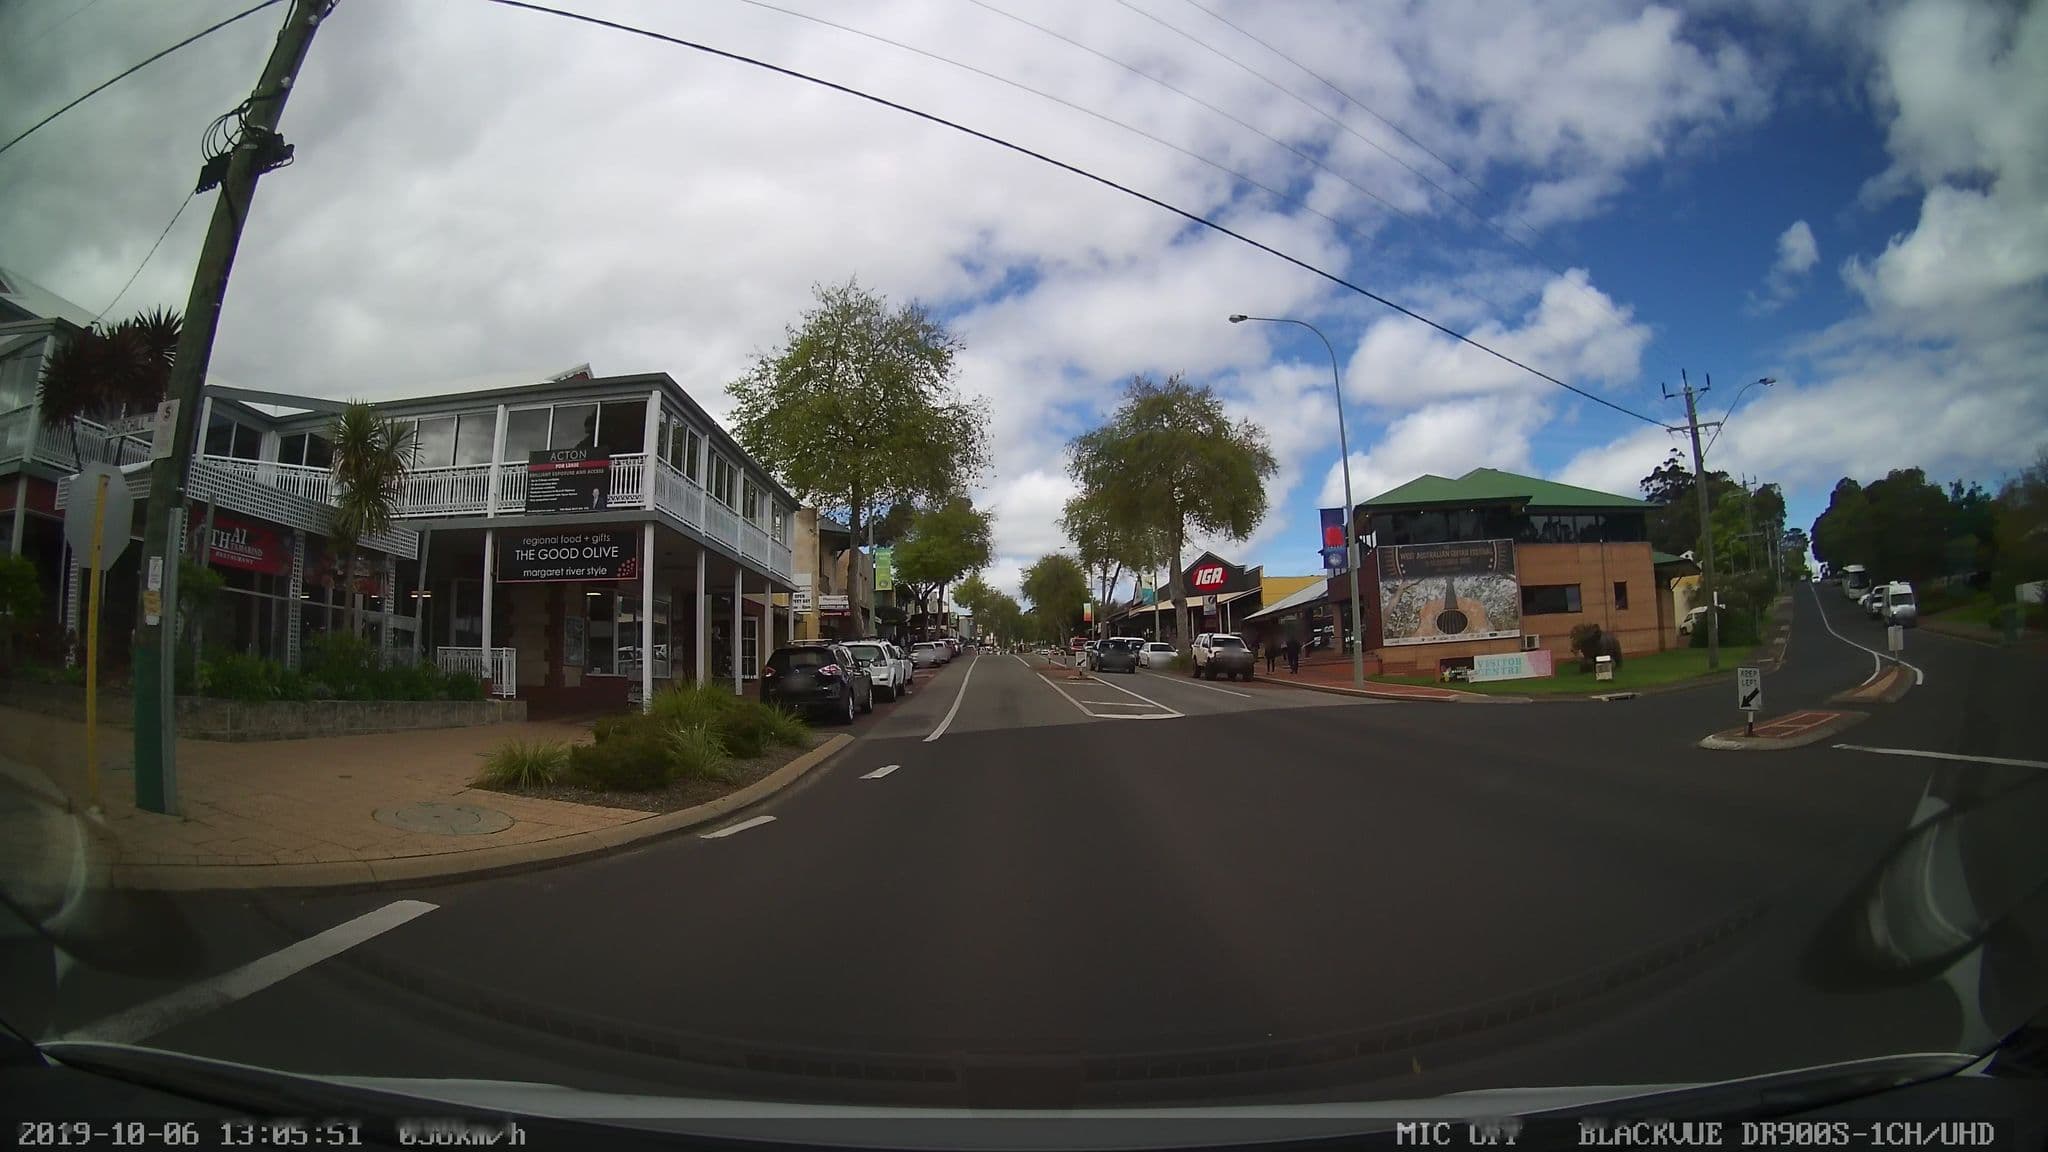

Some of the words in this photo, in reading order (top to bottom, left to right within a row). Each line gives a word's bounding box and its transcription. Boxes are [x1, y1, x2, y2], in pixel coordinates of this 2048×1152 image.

[550, 451, 586, 461] ACTON
[522, 535, 558, 546] regional
[561, 534, 581, 544] food
[592, 533, 611, 544] gifts
[515, 549, 535, 561] THE
[538, 548, 579, 560] GOOD
[582, 546, 619, 559] OLIVE
[523, 568, 564, 578] margaret
[566, 567, 584, 576] river
[587, 566, 607, 577] style
[1478, 658, 1521, 667] VISITOR
[1478, 666, 1521, 675] CENTRE
[1741, 670, 1757, 678] KEEP
